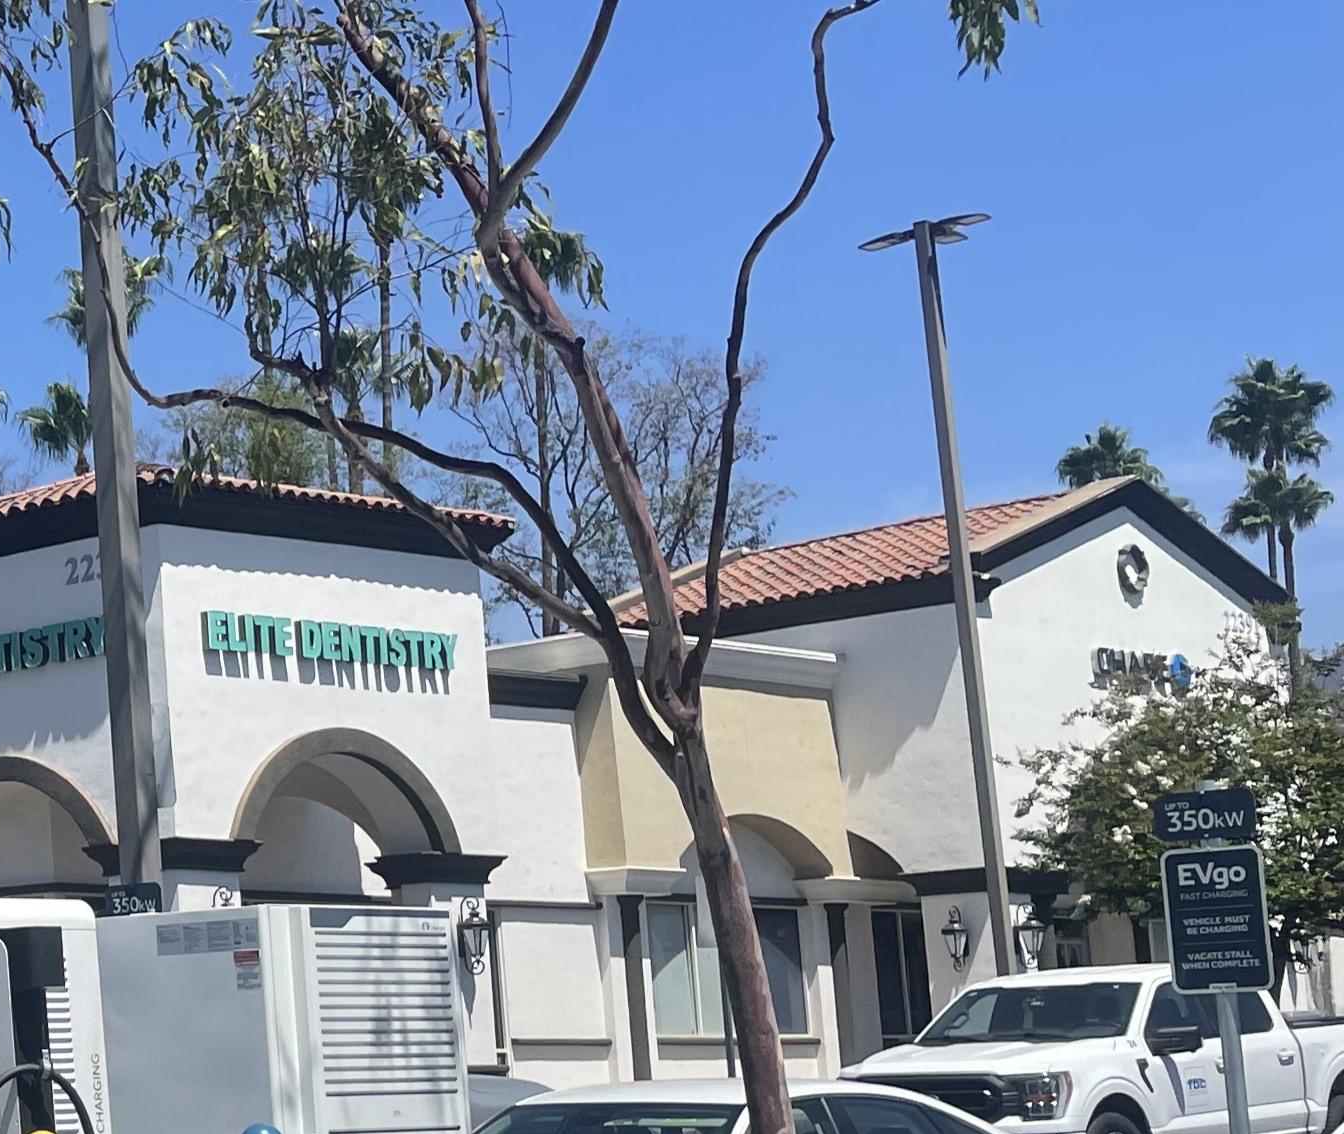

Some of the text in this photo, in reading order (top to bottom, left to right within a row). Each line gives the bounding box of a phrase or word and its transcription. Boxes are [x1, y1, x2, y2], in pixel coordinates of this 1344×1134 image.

[201, 611, 457, 669] ELITE DENTISTRY
[1165, 802, 1189, 811] UP TO
[1166, 809, 1245, 833] 350kW
[1177, 862, 1247, 890] EVgo
[1180, 889, 1249, 901] FAST CHARGING
[112, 896, 157, 914] 350kW
[1182, 915, 1251, 926] VEHICLE MUST
[1186, 924, 1249, 935] BE CHARGING
[1187, 949, 1254, 961] VACATE STALL
[1181, 959, 1261, 971] WHEN COMPLETE
[90, 1052, 106, 1134] CHARGING
